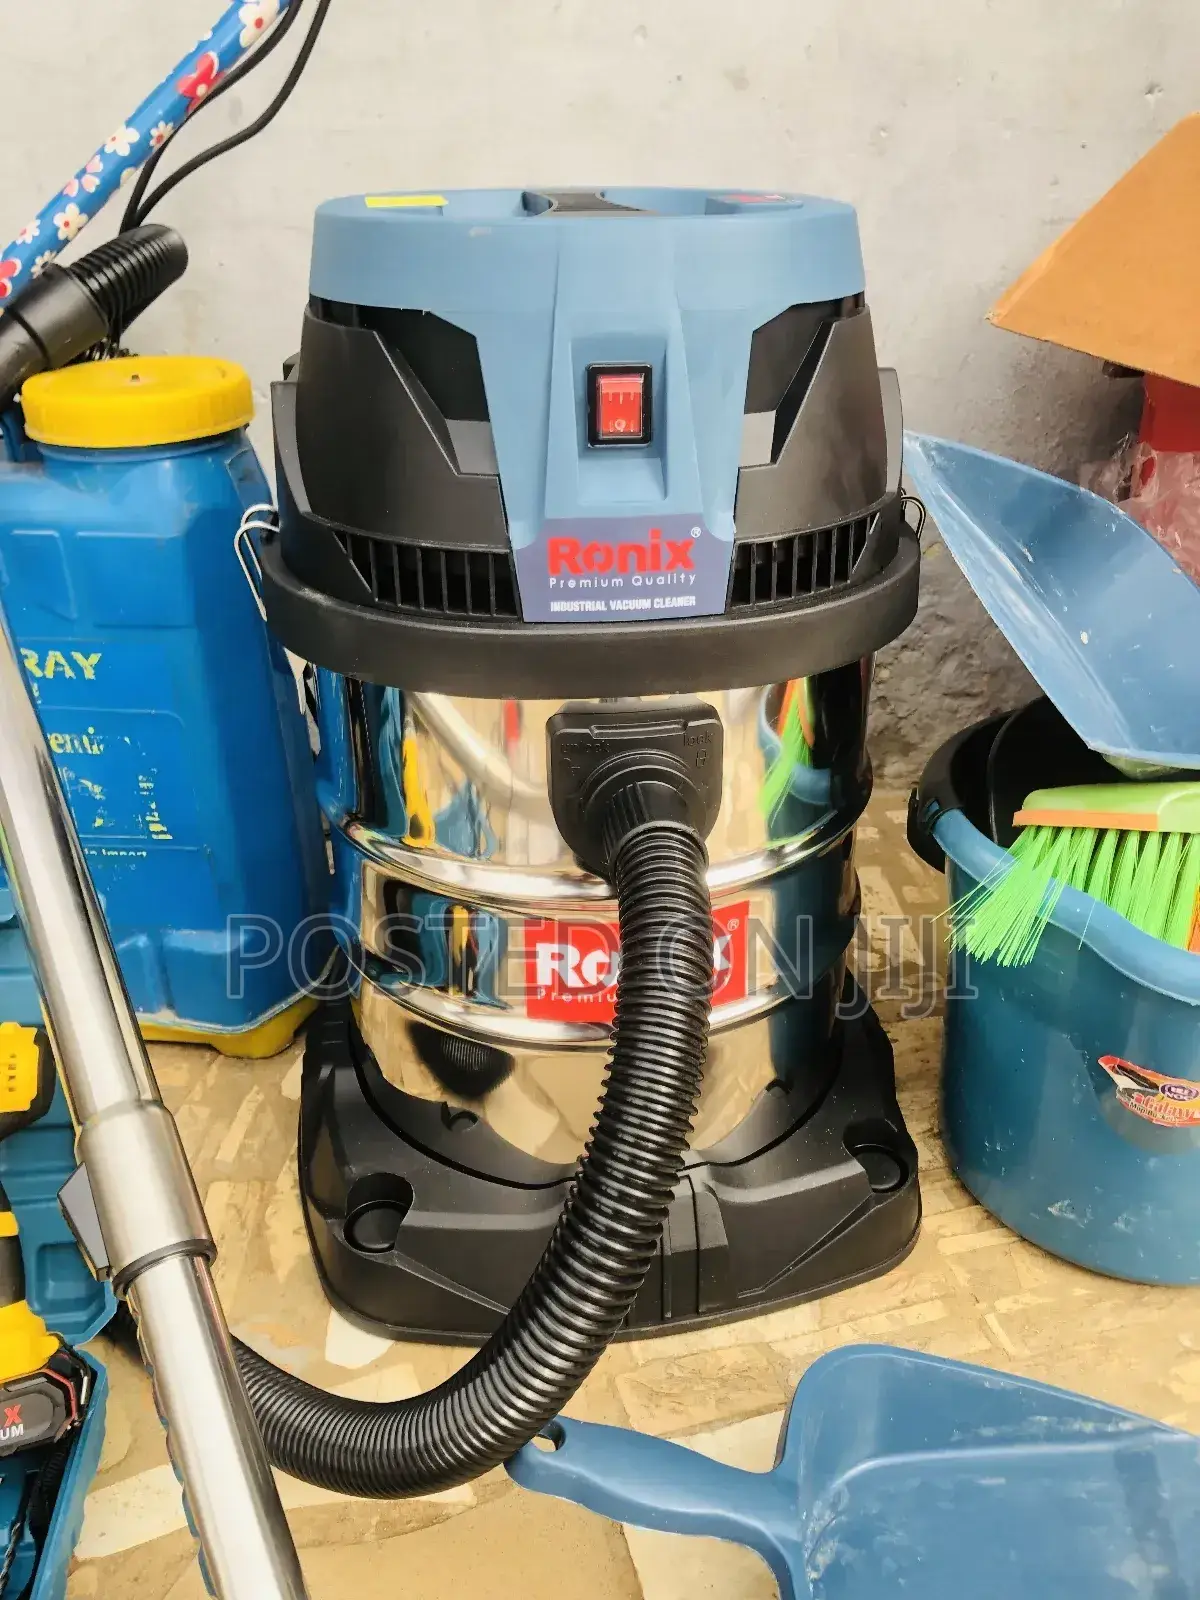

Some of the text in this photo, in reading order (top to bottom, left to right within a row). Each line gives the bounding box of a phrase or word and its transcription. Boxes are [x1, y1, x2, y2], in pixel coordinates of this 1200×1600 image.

[547, 528, 695, 577] Ronix
[549, 572, 696, 589] Premium Quality
[550, 595, 696, 612] INDUSTRIAL VACUUM CLEANER
[536, 987, 617, 1004] Premiu
